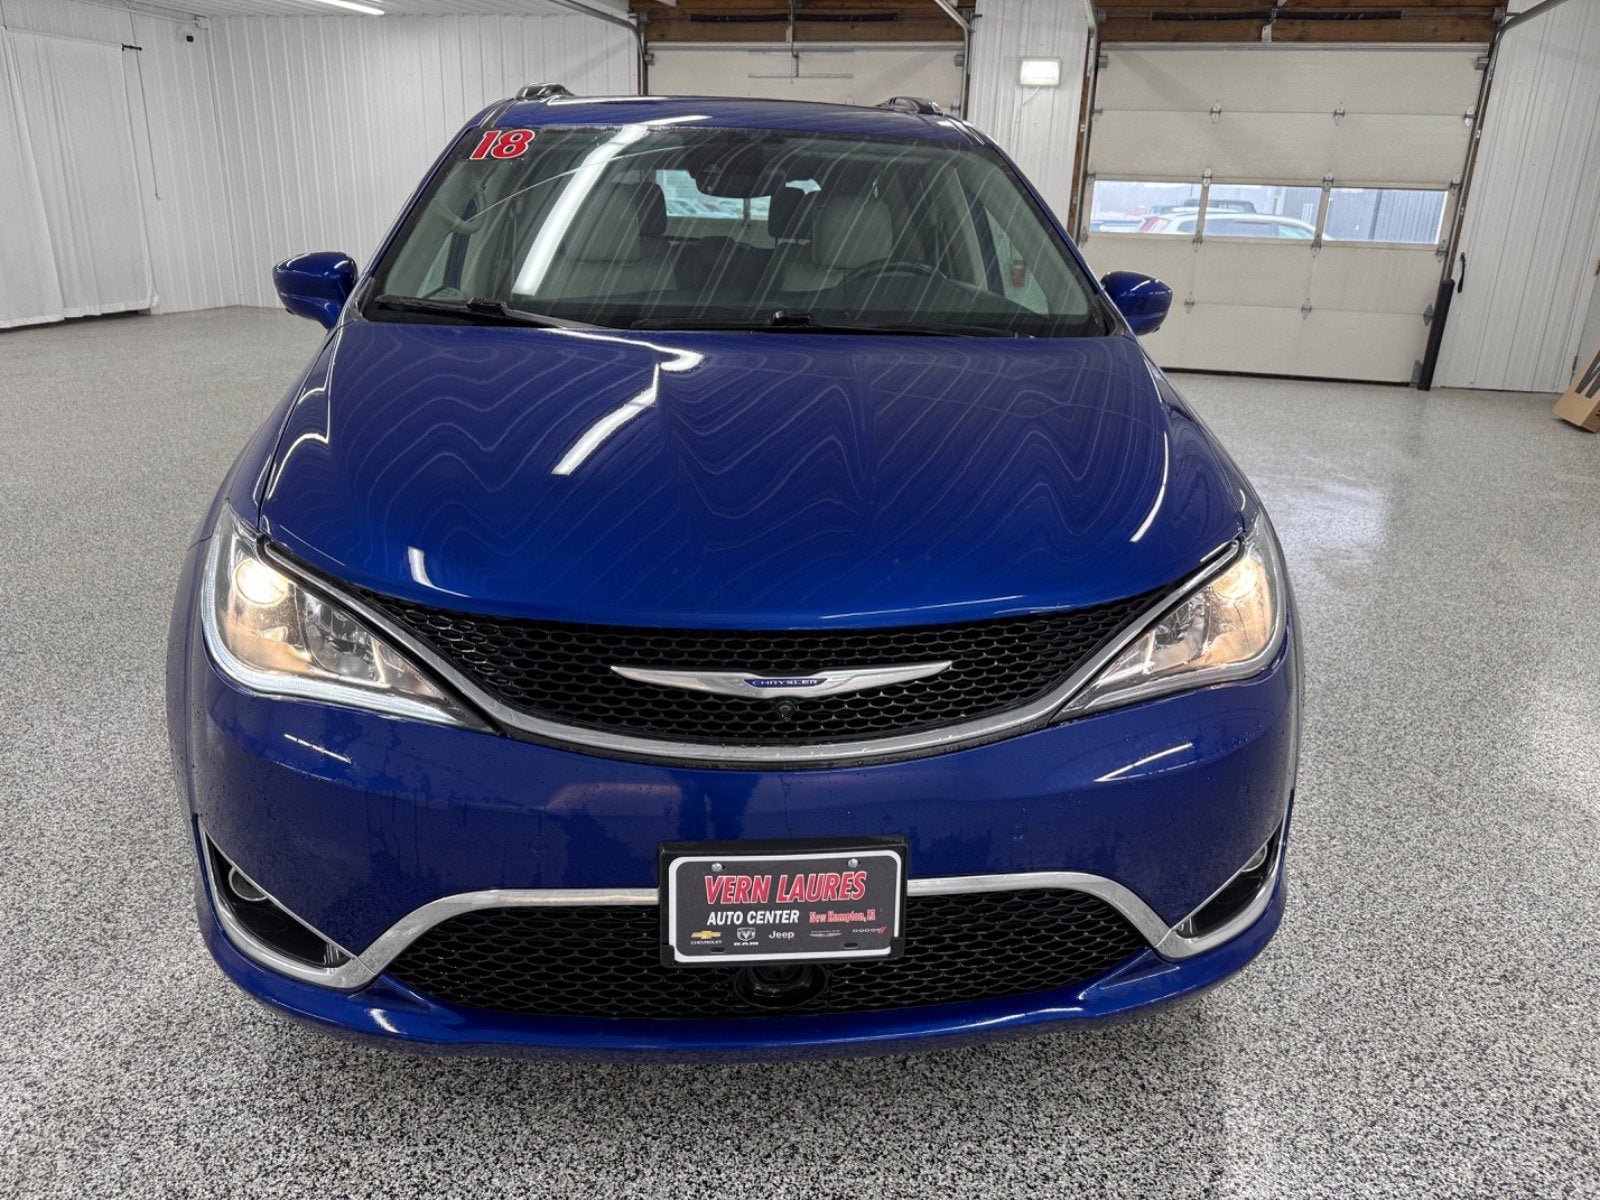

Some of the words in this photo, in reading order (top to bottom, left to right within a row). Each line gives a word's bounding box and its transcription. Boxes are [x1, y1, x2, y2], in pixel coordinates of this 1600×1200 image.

[469, 129, 536, 160] 18
[704, 875, 772, 904] VERN
[775, 871, 867, 903] LAURES
[706, 911, 744, 926] AUTO
[746, 910, 800, 925] CENTER
[808, 911, 827, 923] New
[768, 930, 795, 940] Jeep
